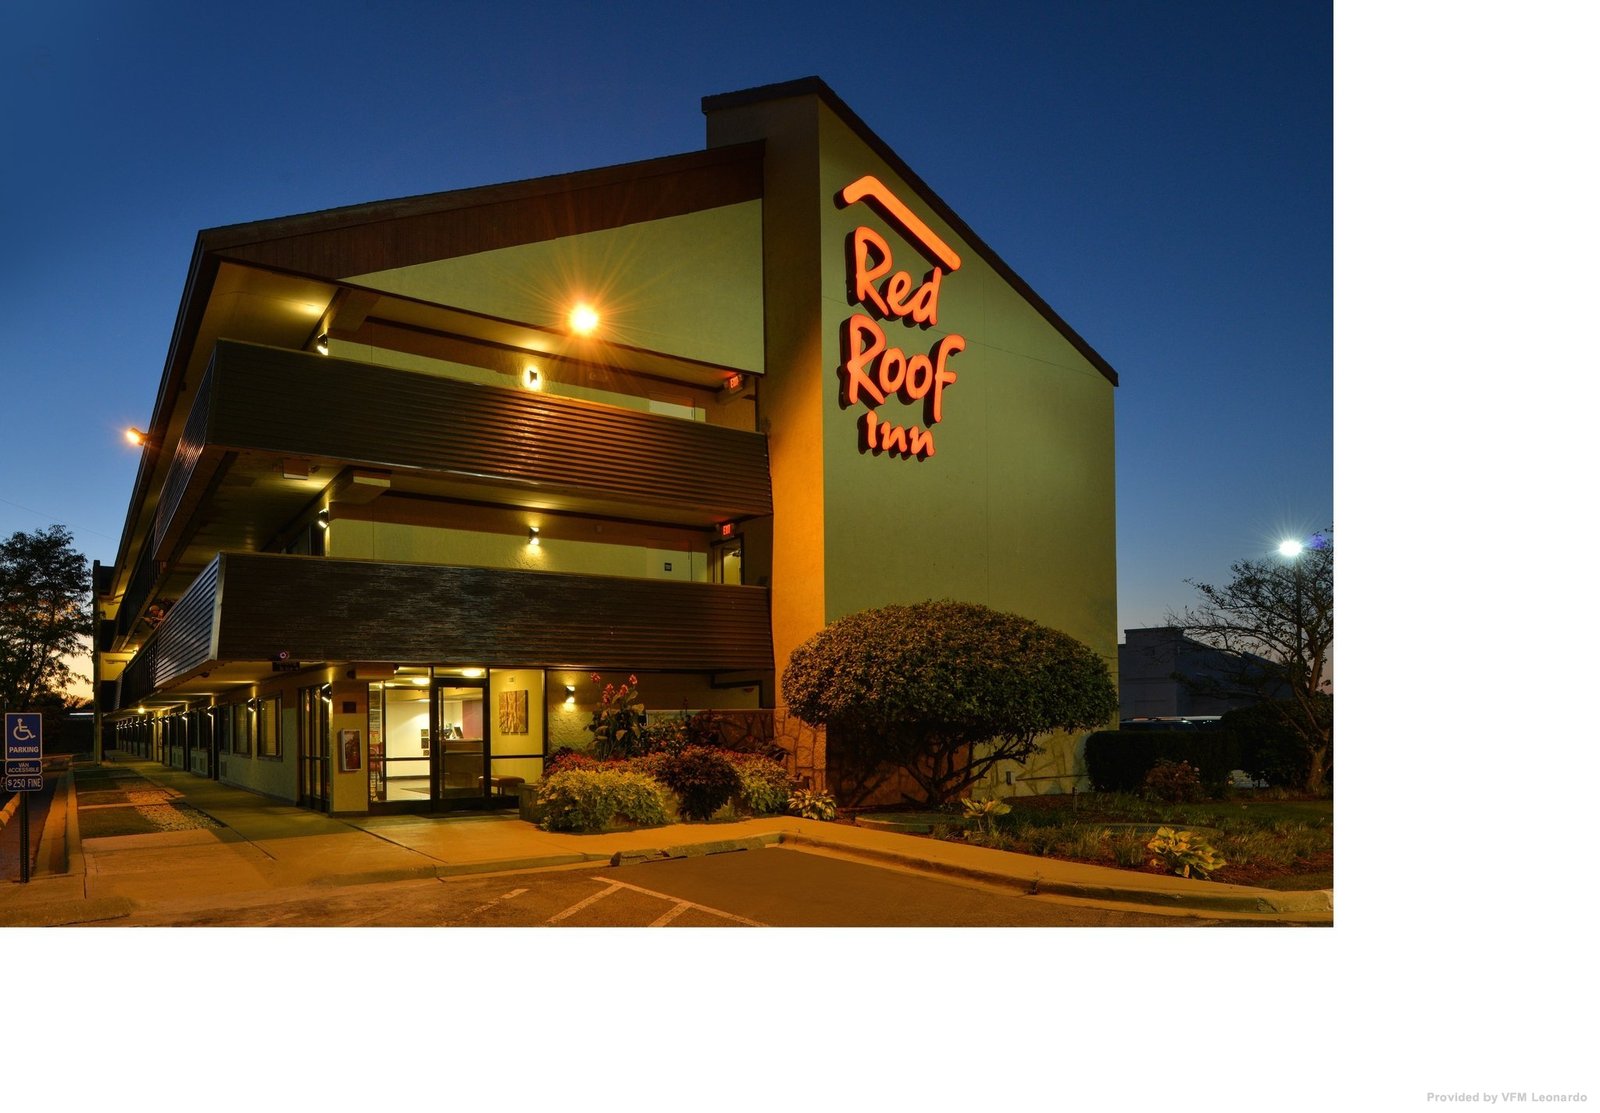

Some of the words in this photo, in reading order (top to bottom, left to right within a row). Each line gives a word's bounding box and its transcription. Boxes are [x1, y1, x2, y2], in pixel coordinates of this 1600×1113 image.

[854, 226, 942, 326] Red
[847, 313, 966, 423] Roof
[866, 410, 935, 457] Inn
[27, 778, 41, 788] FINE
